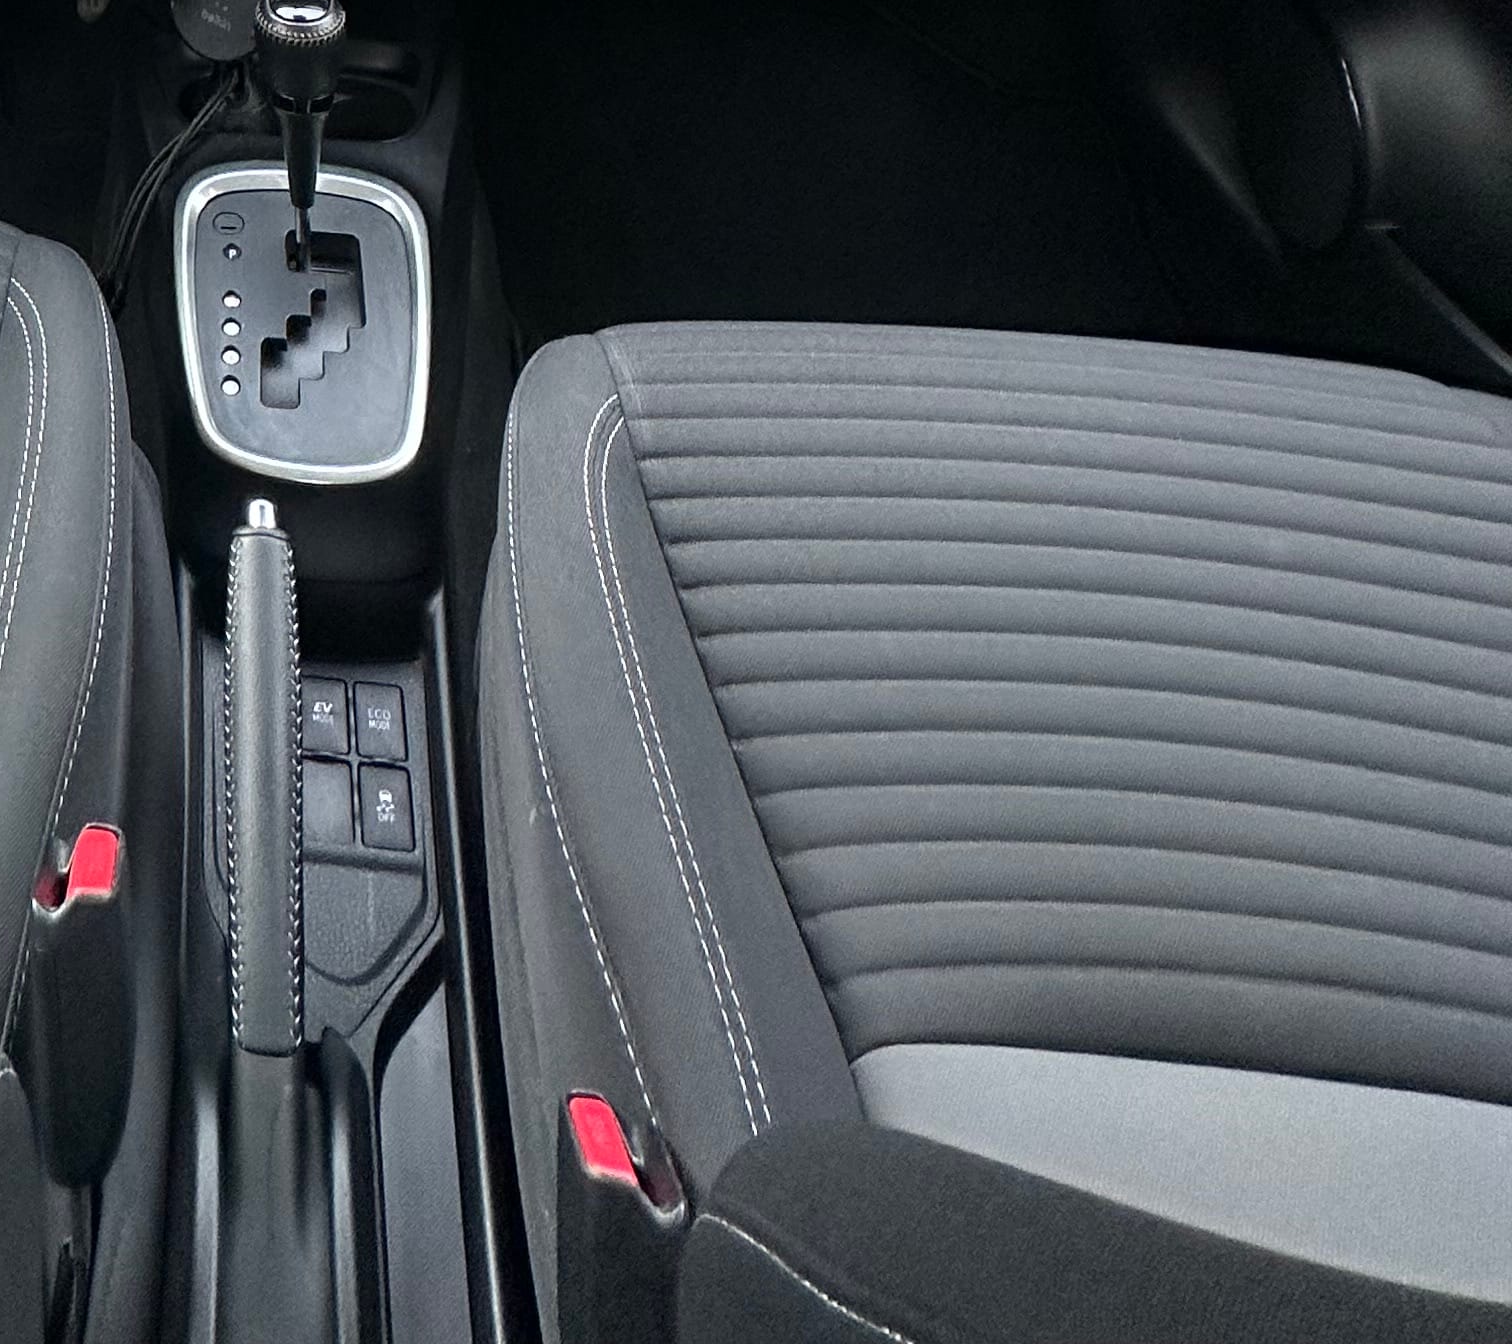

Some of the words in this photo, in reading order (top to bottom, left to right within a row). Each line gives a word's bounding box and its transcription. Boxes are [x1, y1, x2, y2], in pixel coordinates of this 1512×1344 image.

[228, 248, 237, 259] P
[313, 701, 333, 713] EV
[367, 707, 391, 721] ECO
[368, 719, 391, 730] MODE
[377, 812, 395, 823] OFF
